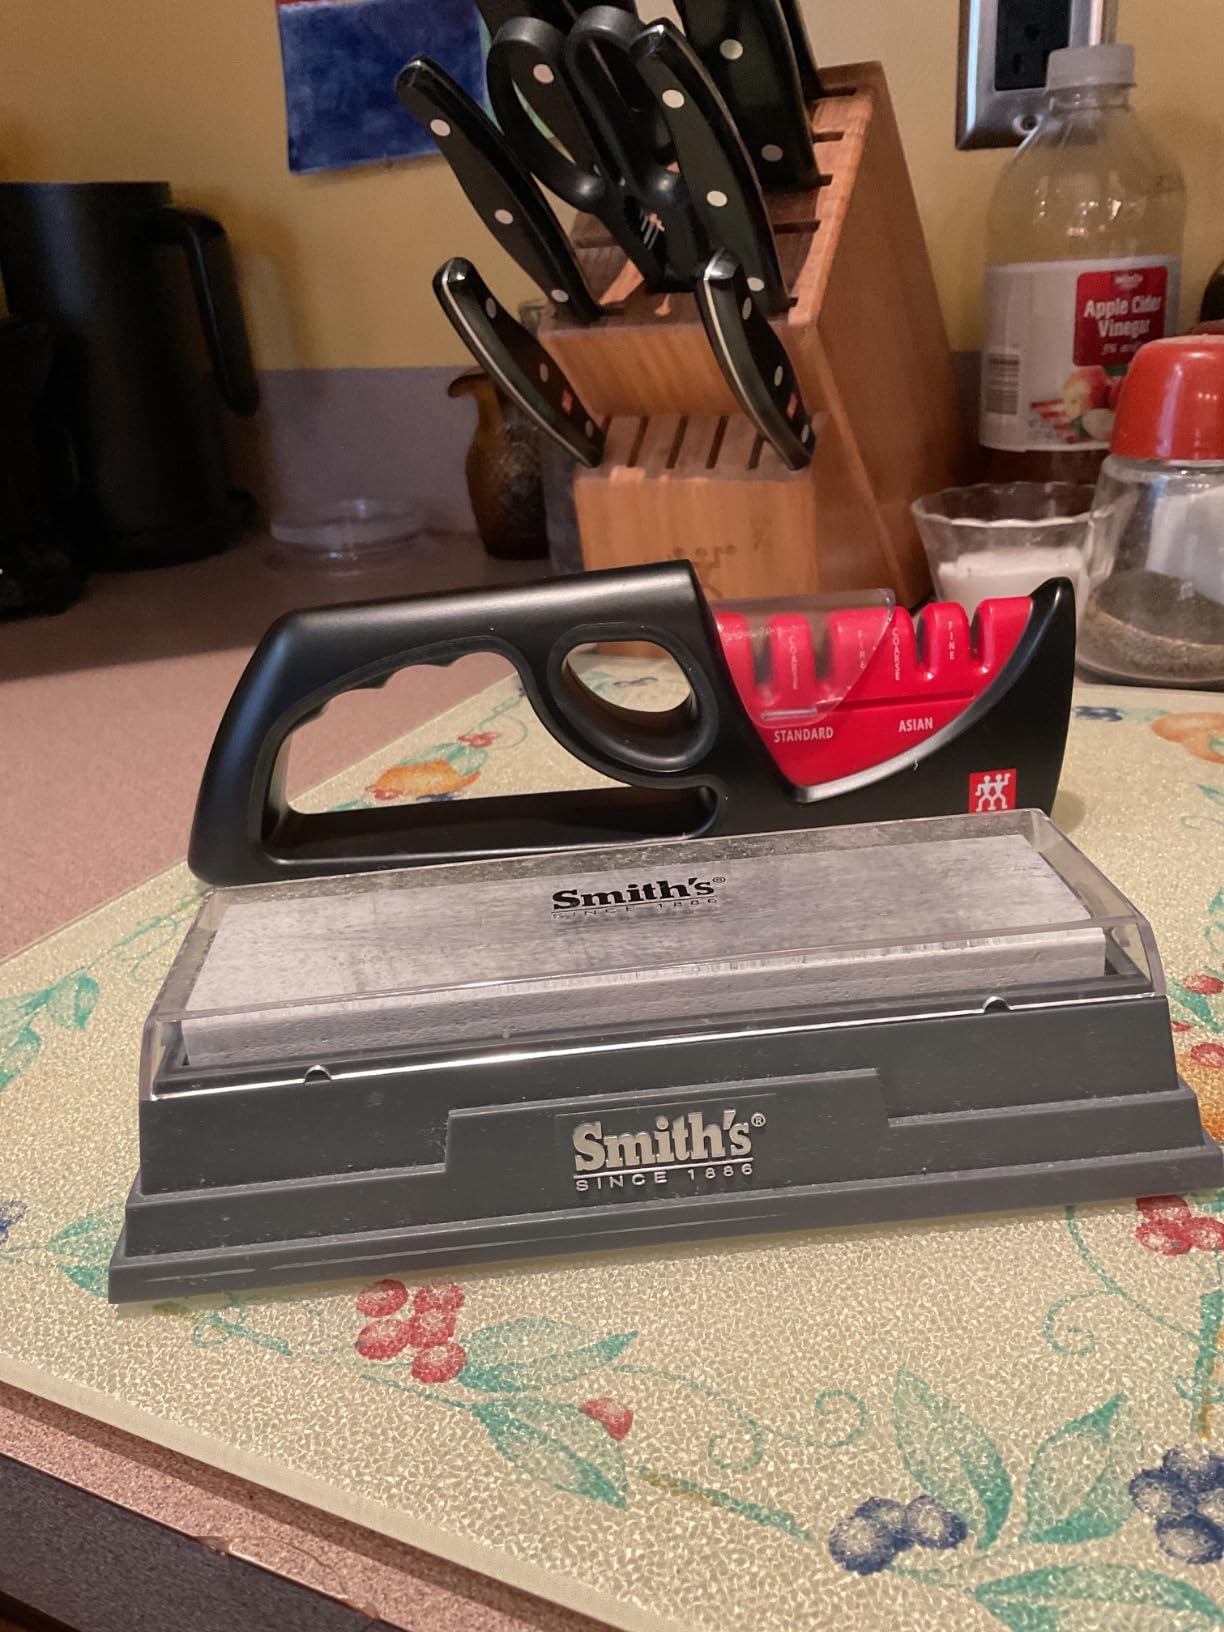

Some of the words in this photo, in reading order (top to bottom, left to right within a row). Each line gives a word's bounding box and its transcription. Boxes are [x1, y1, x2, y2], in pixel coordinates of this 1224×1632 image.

[1083, 298, 1128, 320] Apple
[1131, 294, 1162, 313] Cider
[1098, 319, 1151, 339] Vinegar
[892, 627, 901, 681] COARSE
[774, 726, 834, 744] STANDARD
[899, 717, 933, 733] ASIAN
[552, 877, 714, 910] Smith's
[573, 1109, 752, 1172] Smith's
[575, 1171, 668, 1192] SINCE
[687, 1163, 754, 1182] 1886
